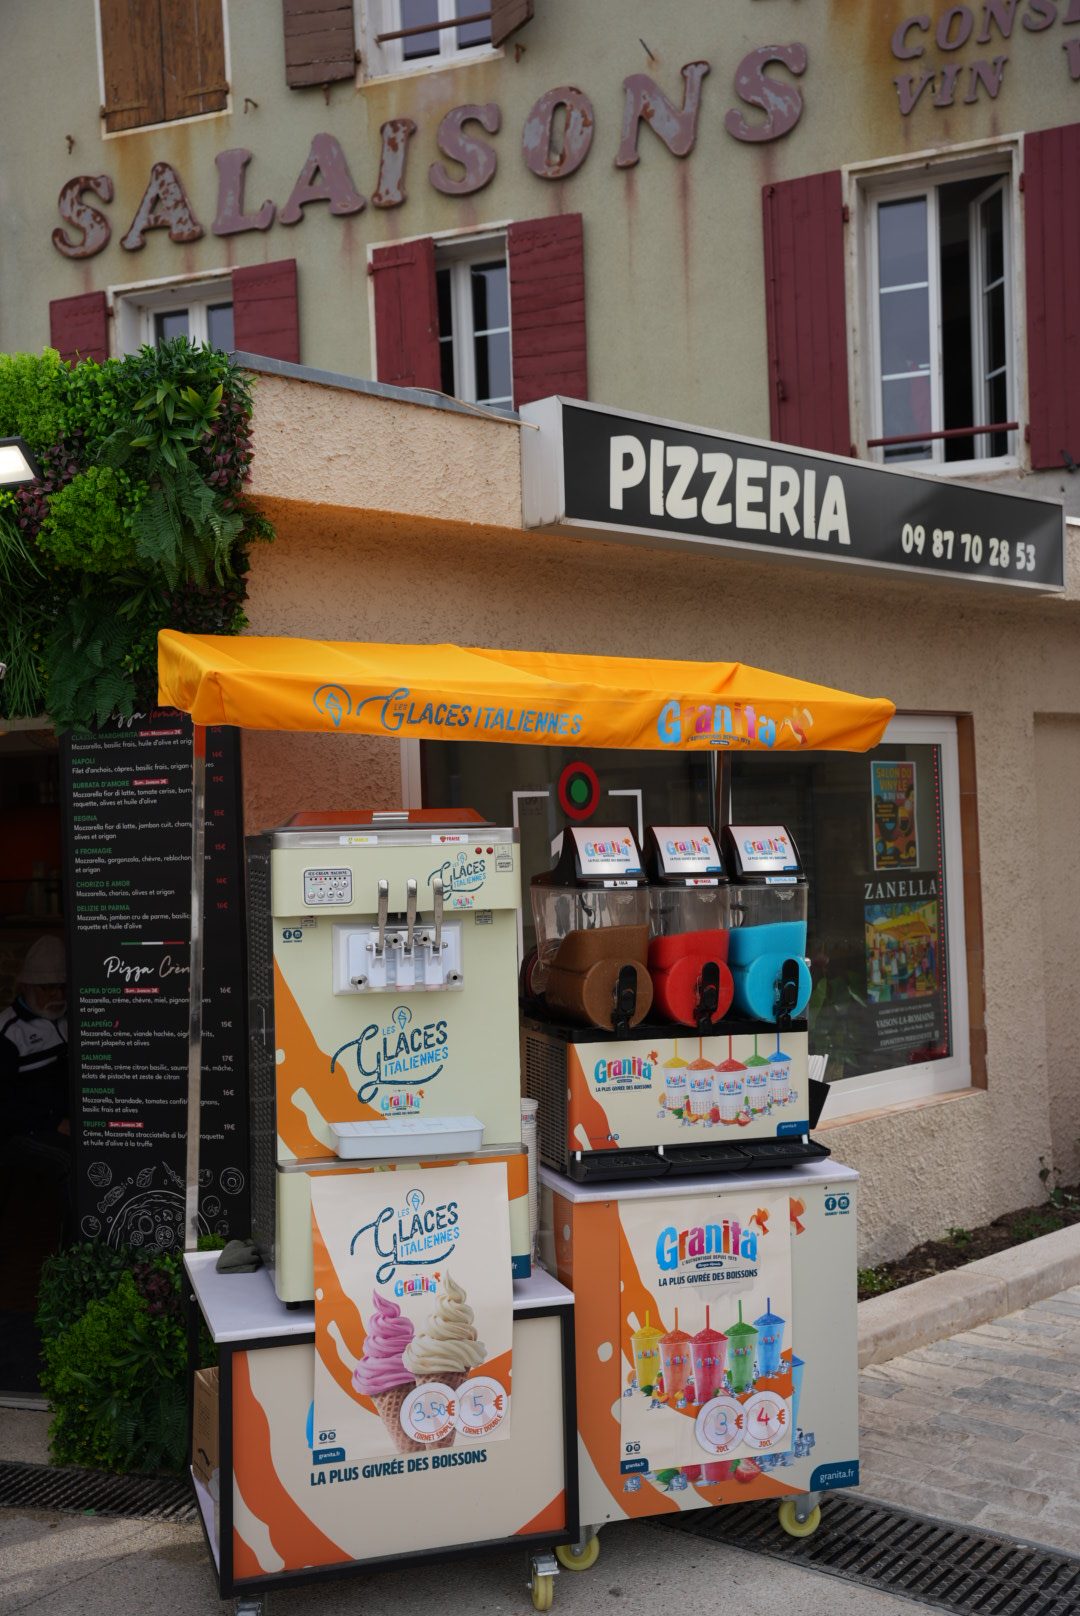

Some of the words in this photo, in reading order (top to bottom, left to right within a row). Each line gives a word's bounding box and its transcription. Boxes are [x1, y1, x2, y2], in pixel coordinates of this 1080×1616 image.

[893, 56, 1009, 117] VIN
[52, 42, 809, 260] SALAISONS
[610, 434, 851, 546] PIZZERIA
[901, 523, 925, 554] 09
[932, 530, 955, 560] 87
[961, 534, 983, 564] 70
[989, 538, 1010, 568] 28
[1015, 541, 1036, 572] 53
[357, 688, 470, 732] GLACES
[474, 706, 584, 735] ITALIENNES
[657, 699, 777, 749] Granita
[864, 879, 937, 900] ZANELLA
[103, 956, 155, 982] Pizza
[220, 986, 232, 994] 16€
[221, 1020, 233, 1028] 15€
[382, 1026, 396, 1036] LES
[222, 1054, 234, 1062] 17€
[384, 1047, 448, 1077] ITALIENNES
[594, 1056, 653, 1084] Granita
[223, 1088, 235, 1096] 16€
[223, 1122, 235, 1130] 19€
[397, 1208, 410, 1218] LES
[400, 1227, 460, 1258] ITALIENNES
[655, 1219, 758, 1272] Granita
[394, 1276, 437, 1298] Granita
[658, 1278, 668, 1287] LA
[669, 1275, 686, 1286] PLUS
[687, 1273, 711, 1284] GIVRÉE
[712, 1271, 725, 1281] DES
[726, 1269, 758, 1280] BOISSONS
[414, 1432, 435, 1441] CORNET
[436, 1421, 455, 1439] SIMPLE
[463, 1426, 483, 1435] CORNET
[310, 1472, 326, 1487] LA
[330, 1466, 359, 1484] PLUS
[362, 1459, 404, 1479] GIVRÉE
[407, 1458, 429, 1474] DES
[432, 1449, 488, 1470] BOISSONS
[819, 1469, 855, 1484] granita.fr
